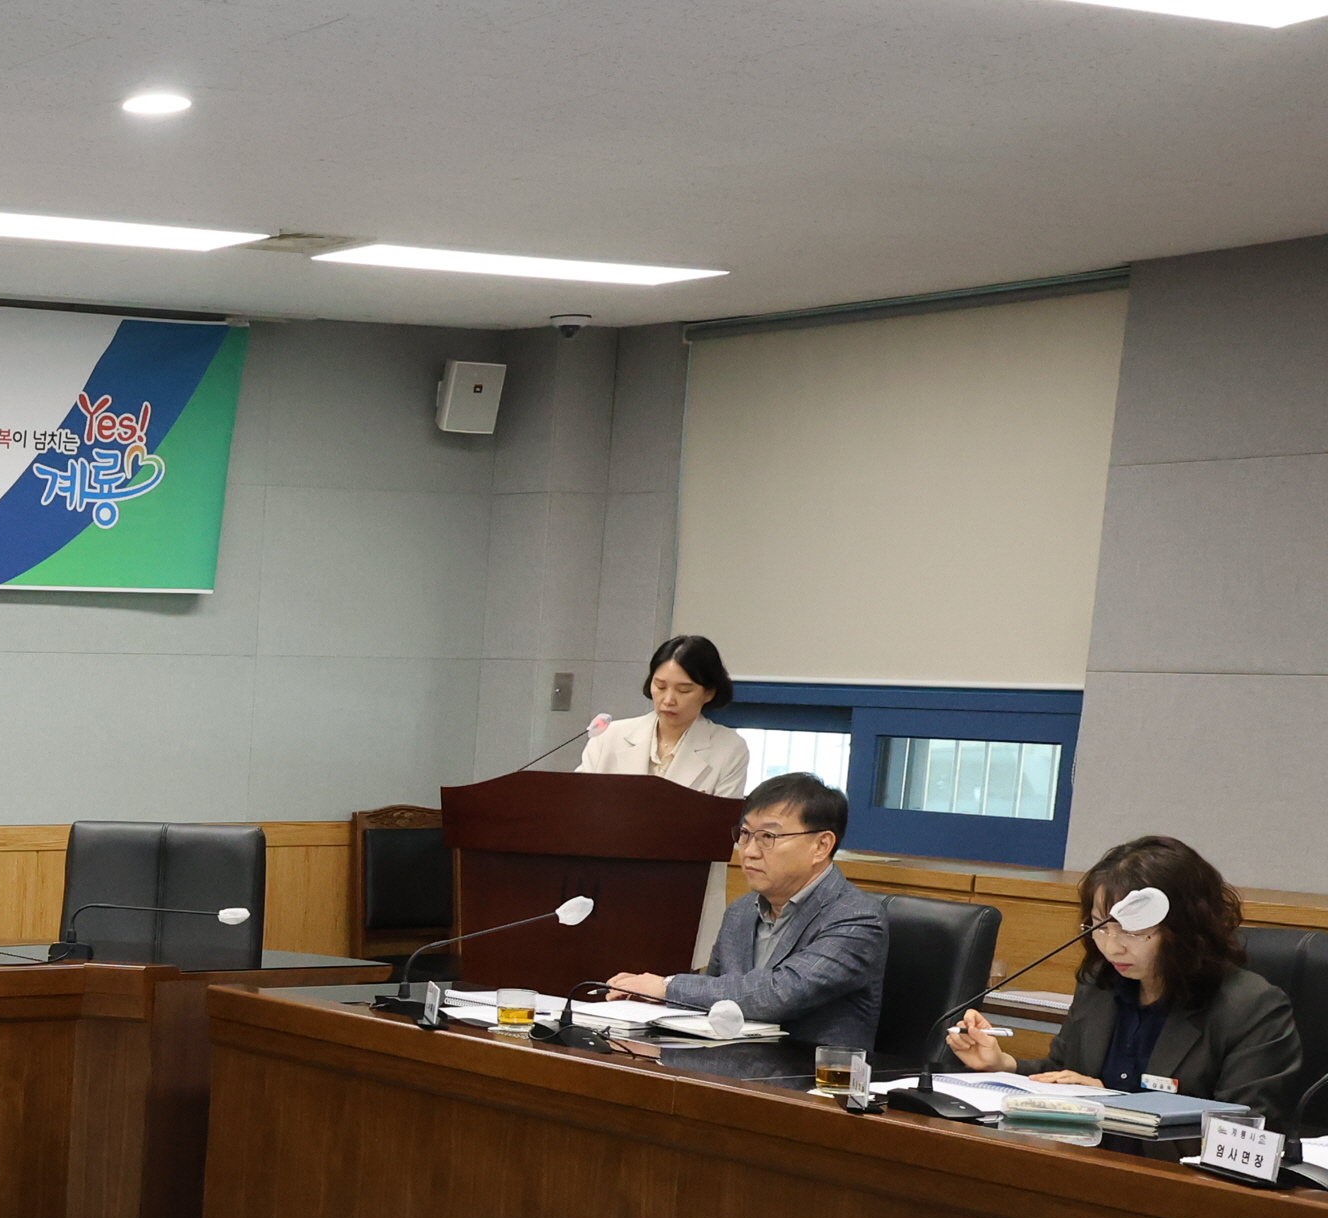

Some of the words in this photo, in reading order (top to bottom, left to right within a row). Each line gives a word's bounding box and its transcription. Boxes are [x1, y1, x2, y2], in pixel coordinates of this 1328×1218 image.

[78, 392, 150, 443] Yes!
[34, 430, 79, 452] 넘치는
[34, 449, 156, 527] 계룡
[1216, 1144, 1264, 1168] 엄사면장
